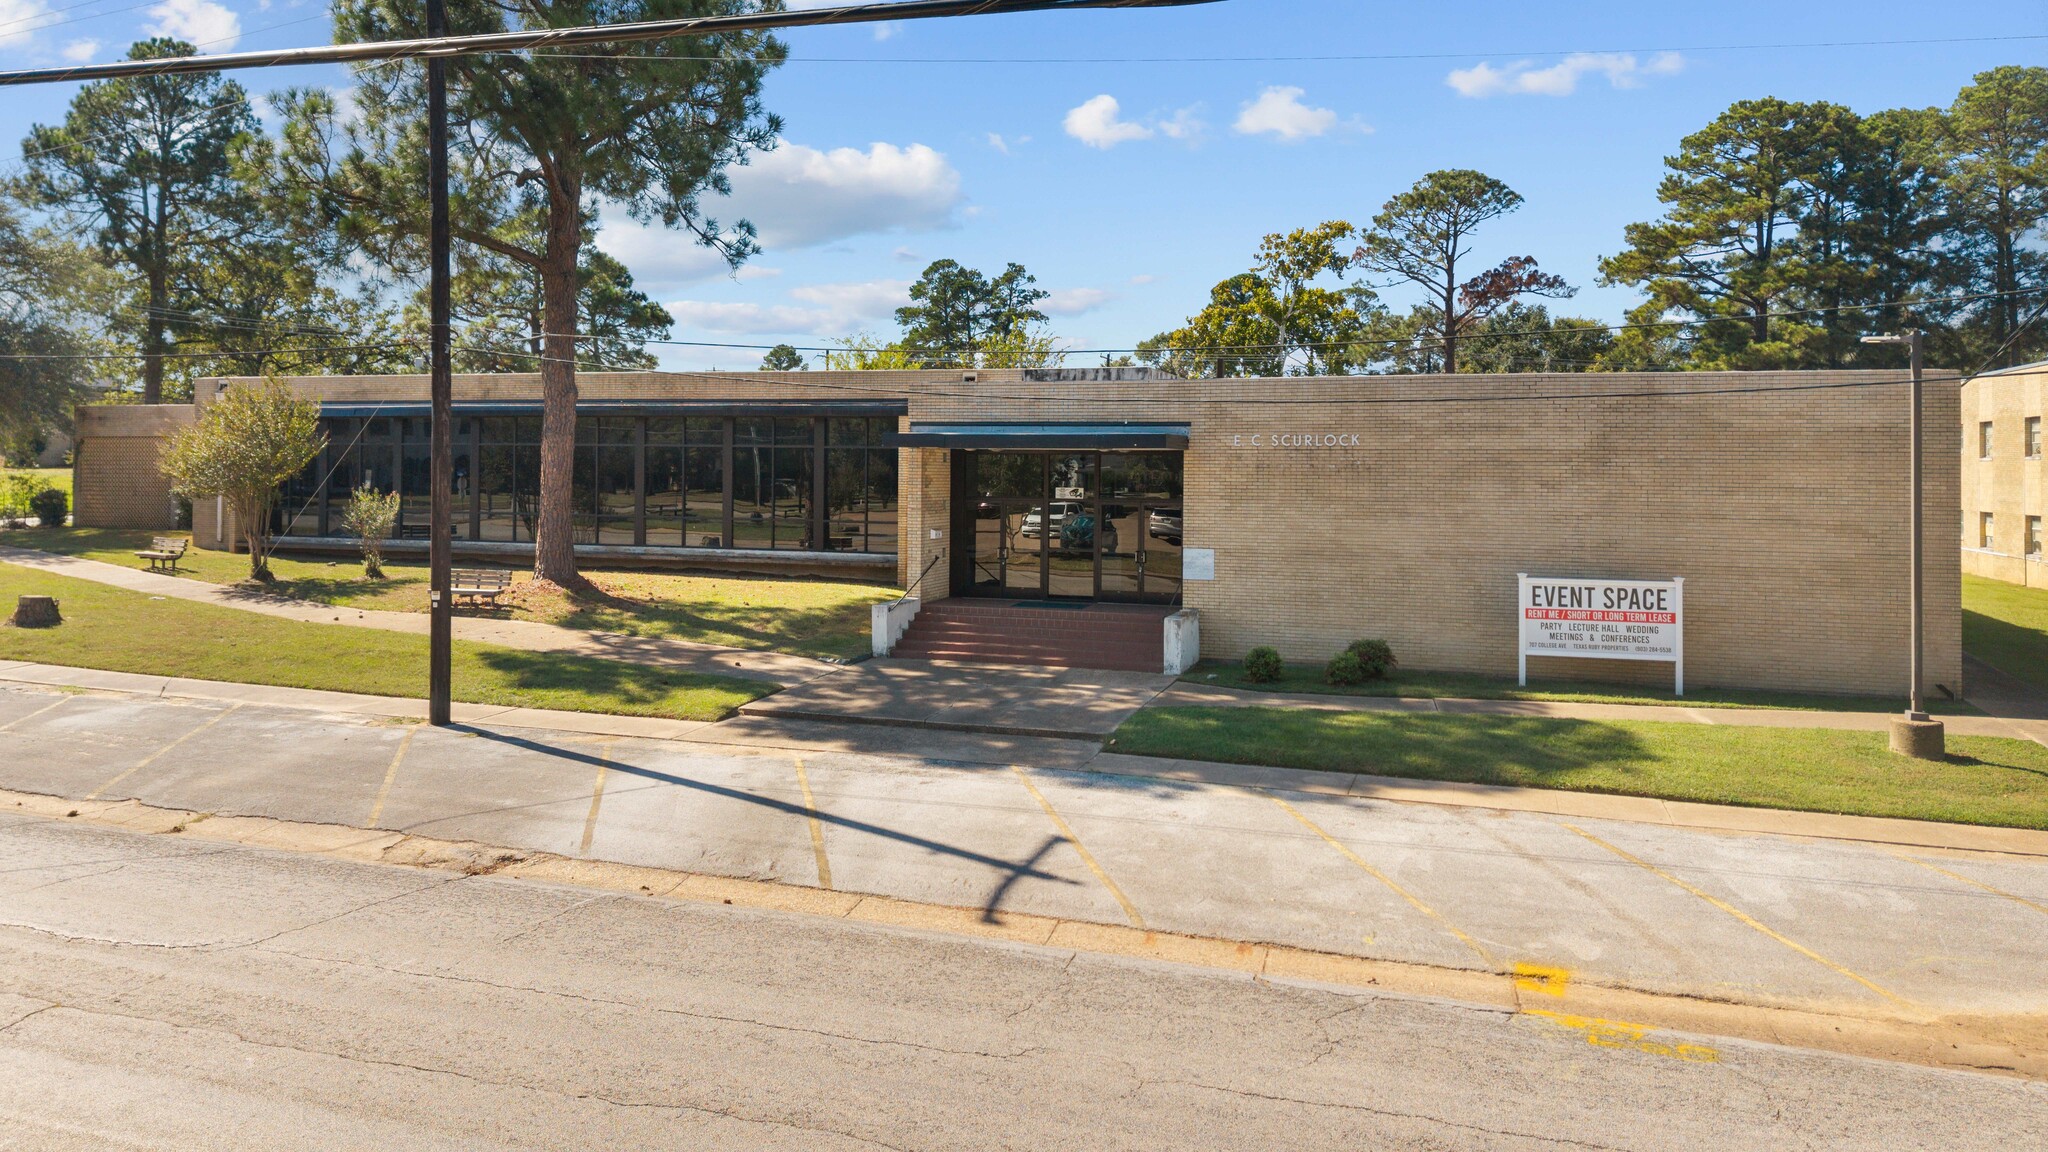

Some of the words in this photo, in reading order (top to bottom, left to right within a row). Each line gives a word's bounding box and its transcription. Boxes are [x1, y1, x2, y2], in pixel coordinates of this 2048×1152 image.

[1271, 434, 1361, 447] SCURLOCK
[1532, 585, 1596, 609] EVENT
[1603, 587, 1668, 611] SPACE
[1527, 609, 1547, 619] RENT
[1548, 610, 1560, 619] ME
[1561, 610, 1566, 619] /
[1567, 611, 1591, 620] SHORT
[1593, 611, 1603, 620] OR
[1604, 612, 1624, 621] LONG
[1626, 612, 1647, 622] TERM
[1648, 613, 1672, 623] LEASE
[1540, 622, 1562, 631] PARTY
[1568, 623, 1600, 632] LECTURE
[1601, 624, 1619, 633] HALL
[1626, 625, 1660, 634] WEDDING
[1549, 632, 1584, 641] MEETINGS
[1589, 633, 1595, 642] &
[1601, 634, 1650, 644] CONFERENCES
[1601, 644, 1629, 652] PROPERTIES
